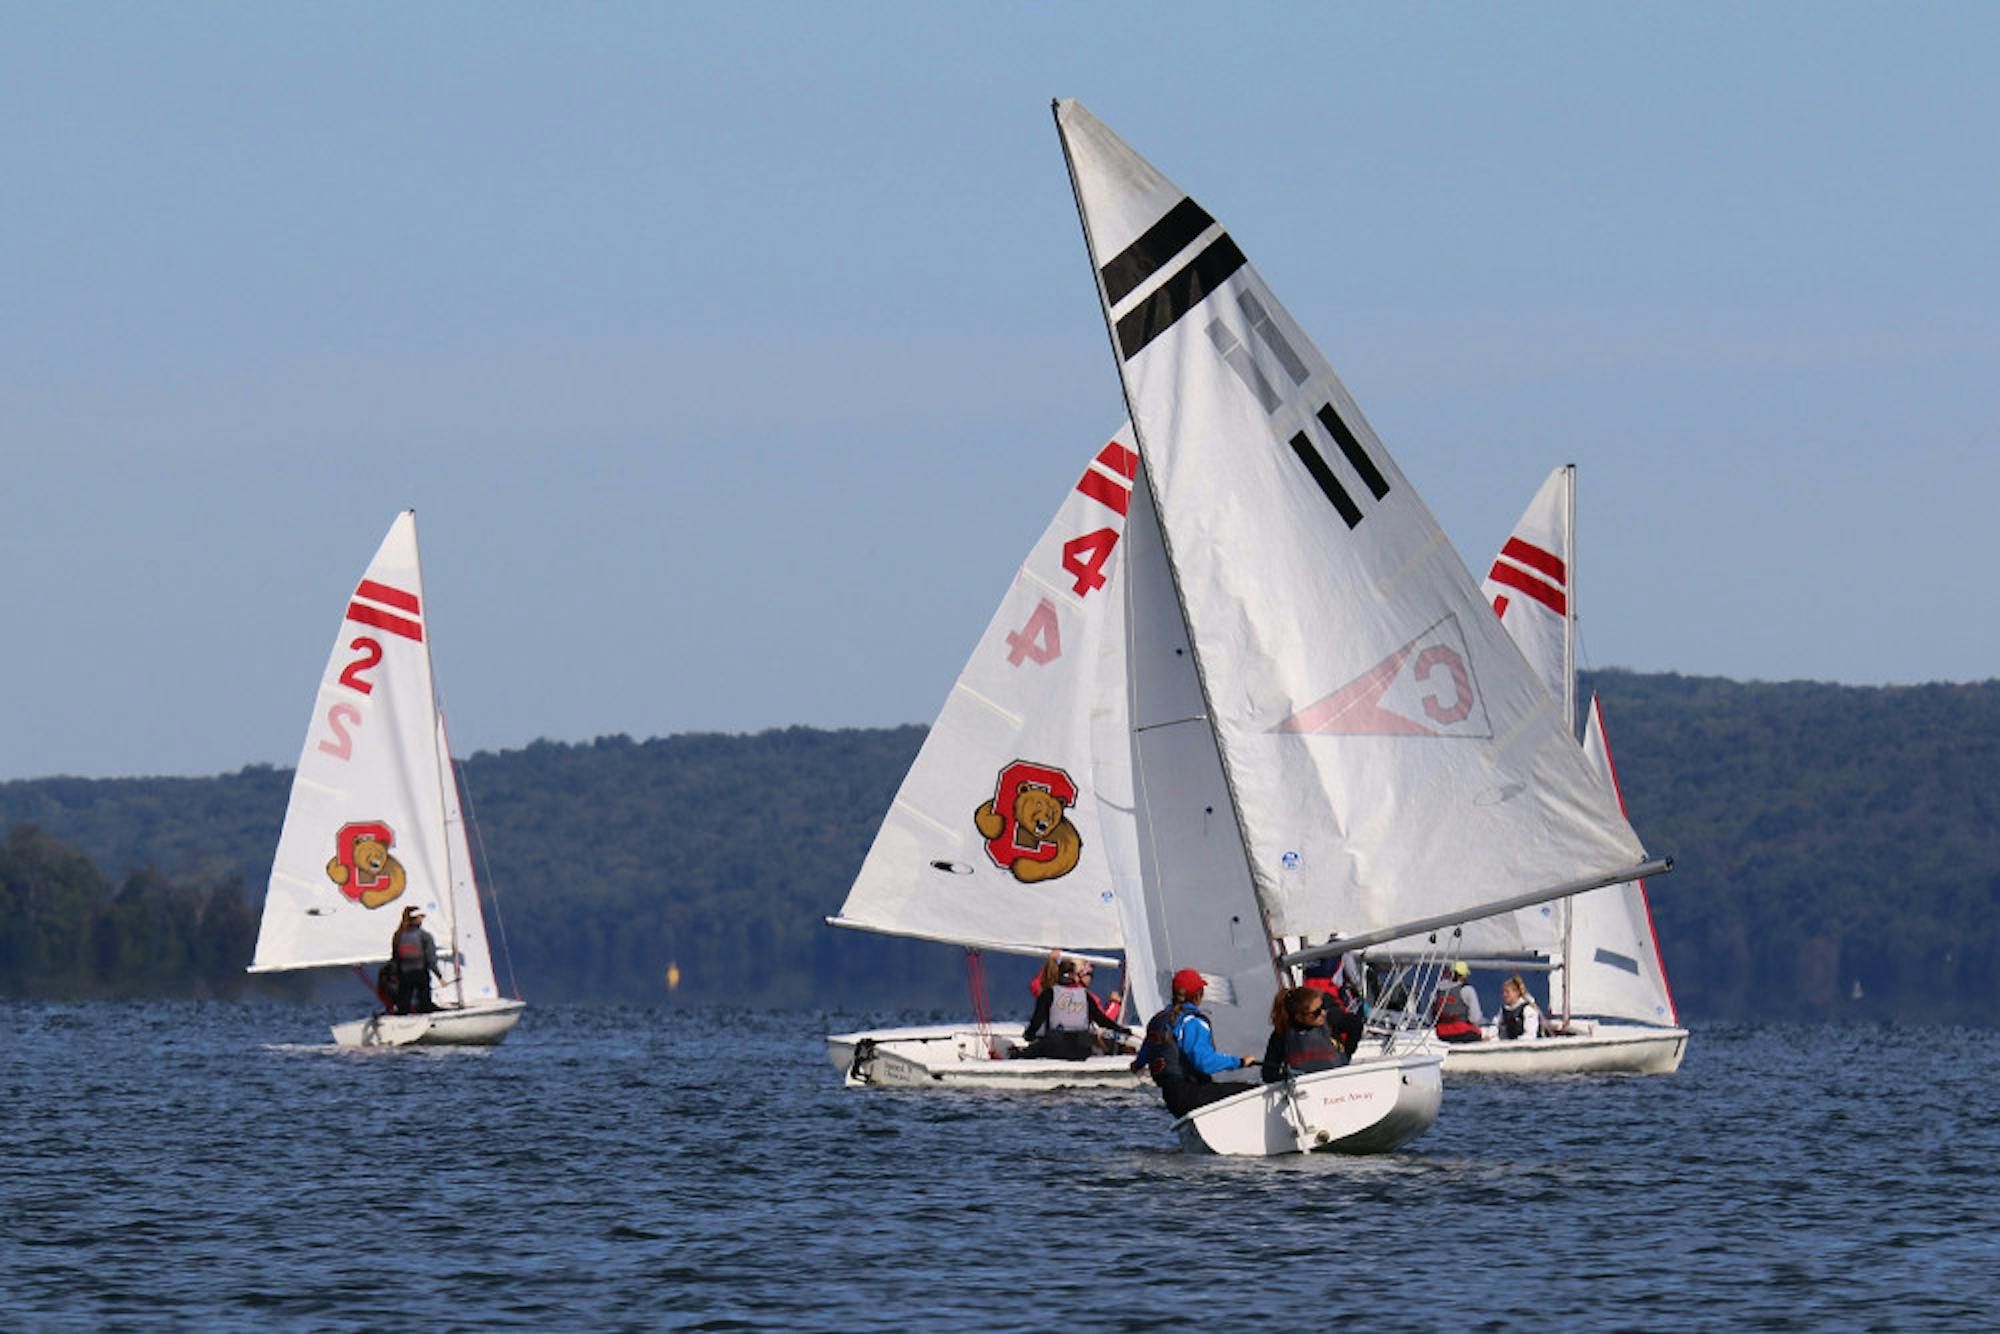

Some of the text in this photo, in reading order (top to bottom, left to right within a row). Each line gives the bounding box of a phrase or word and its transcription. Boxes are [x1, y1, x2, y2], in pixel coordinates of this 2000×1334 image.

[1289, 402, 1390, 530] 11
[1062, 527, 1120, 598] 4
[338, 637, 383, 695] 2
